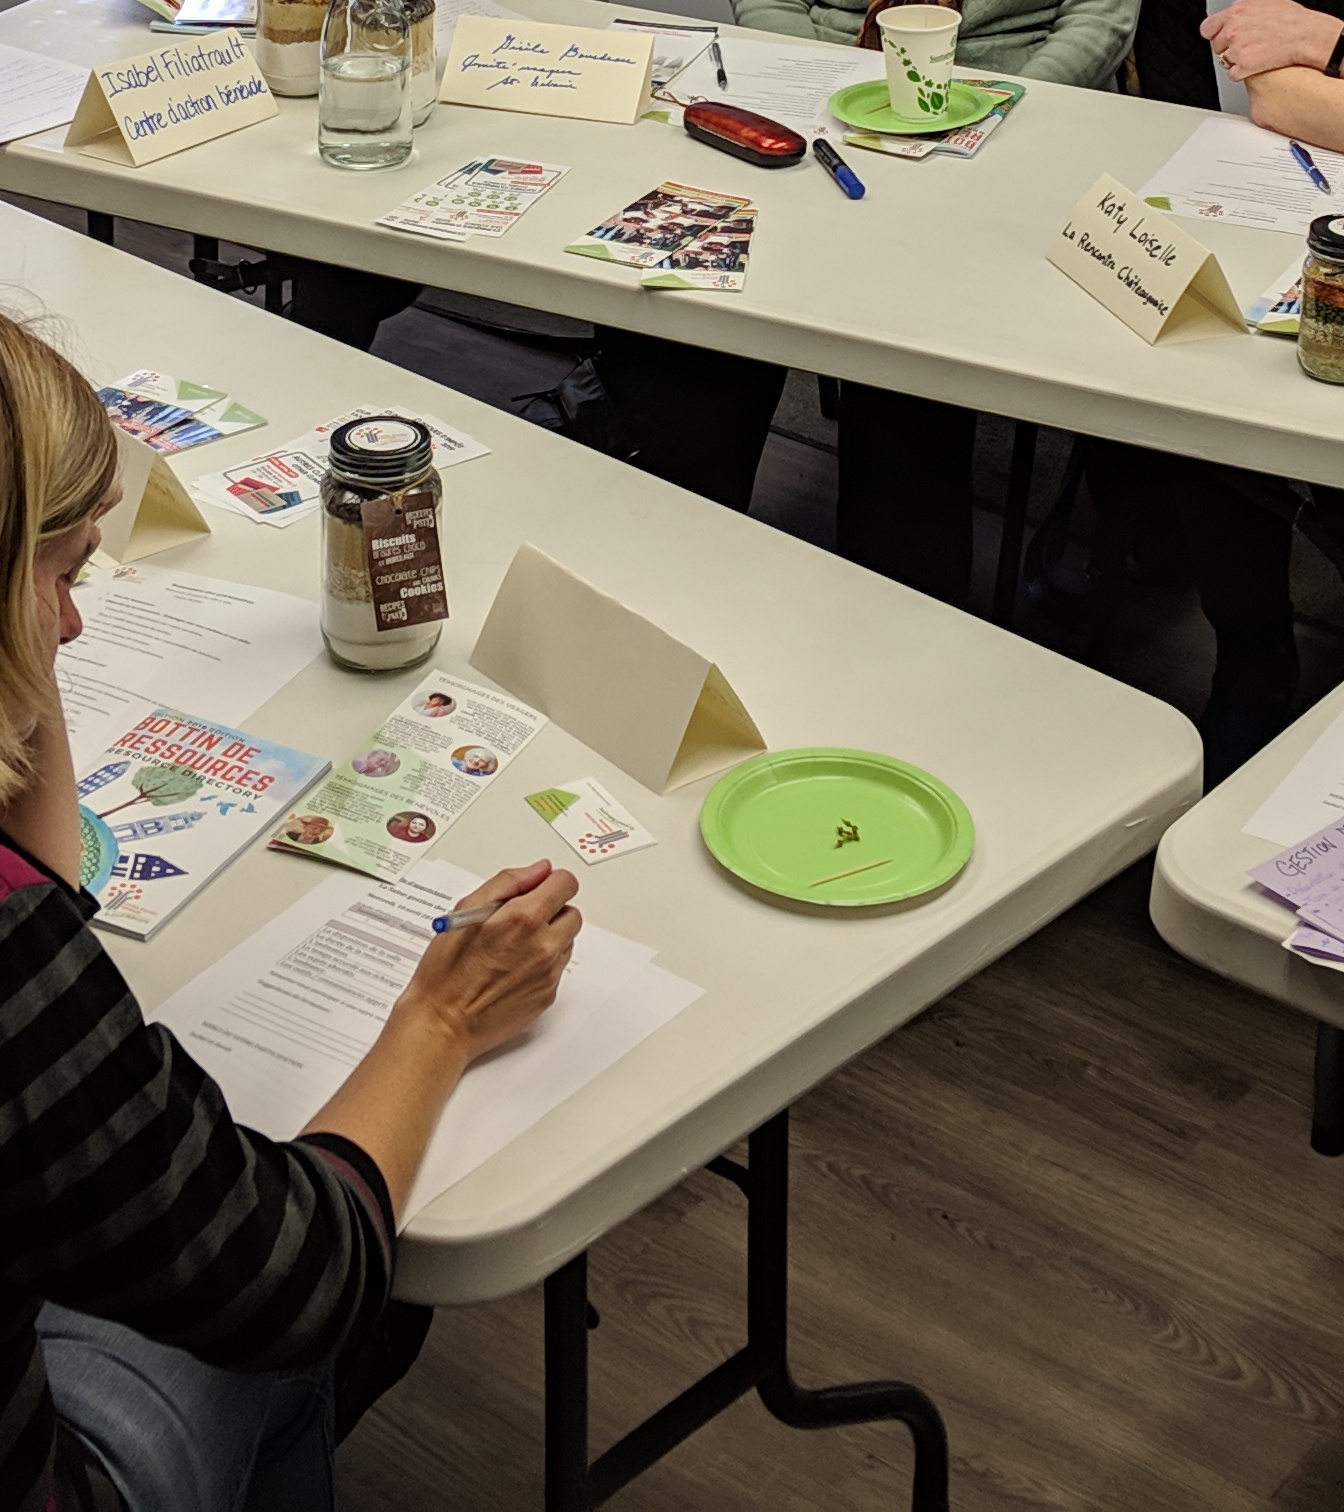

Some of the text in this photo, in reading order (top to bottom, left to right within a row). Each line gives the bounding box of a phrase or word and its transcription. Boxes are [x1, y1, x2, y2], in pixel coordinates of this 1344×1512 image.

[101, 35, 246, 99] Isabel Filiatrault
[124, 111, 168, 141] Centre
[1061, 221, 1076, 241] La
[1096, 191, 1177, 267] Katy Loiselle
[371, 533, 416, 550] Biscuits
[399, 581, 444, 599] Cookies
[113, 732, 276, 793] RESSOURCES
[133, 717, 262, 765] BOTTIN DE
[105, 747, 263, 801] RESOURCE DIRECTORY
[1275, 834, 1339, 879] GESTION
